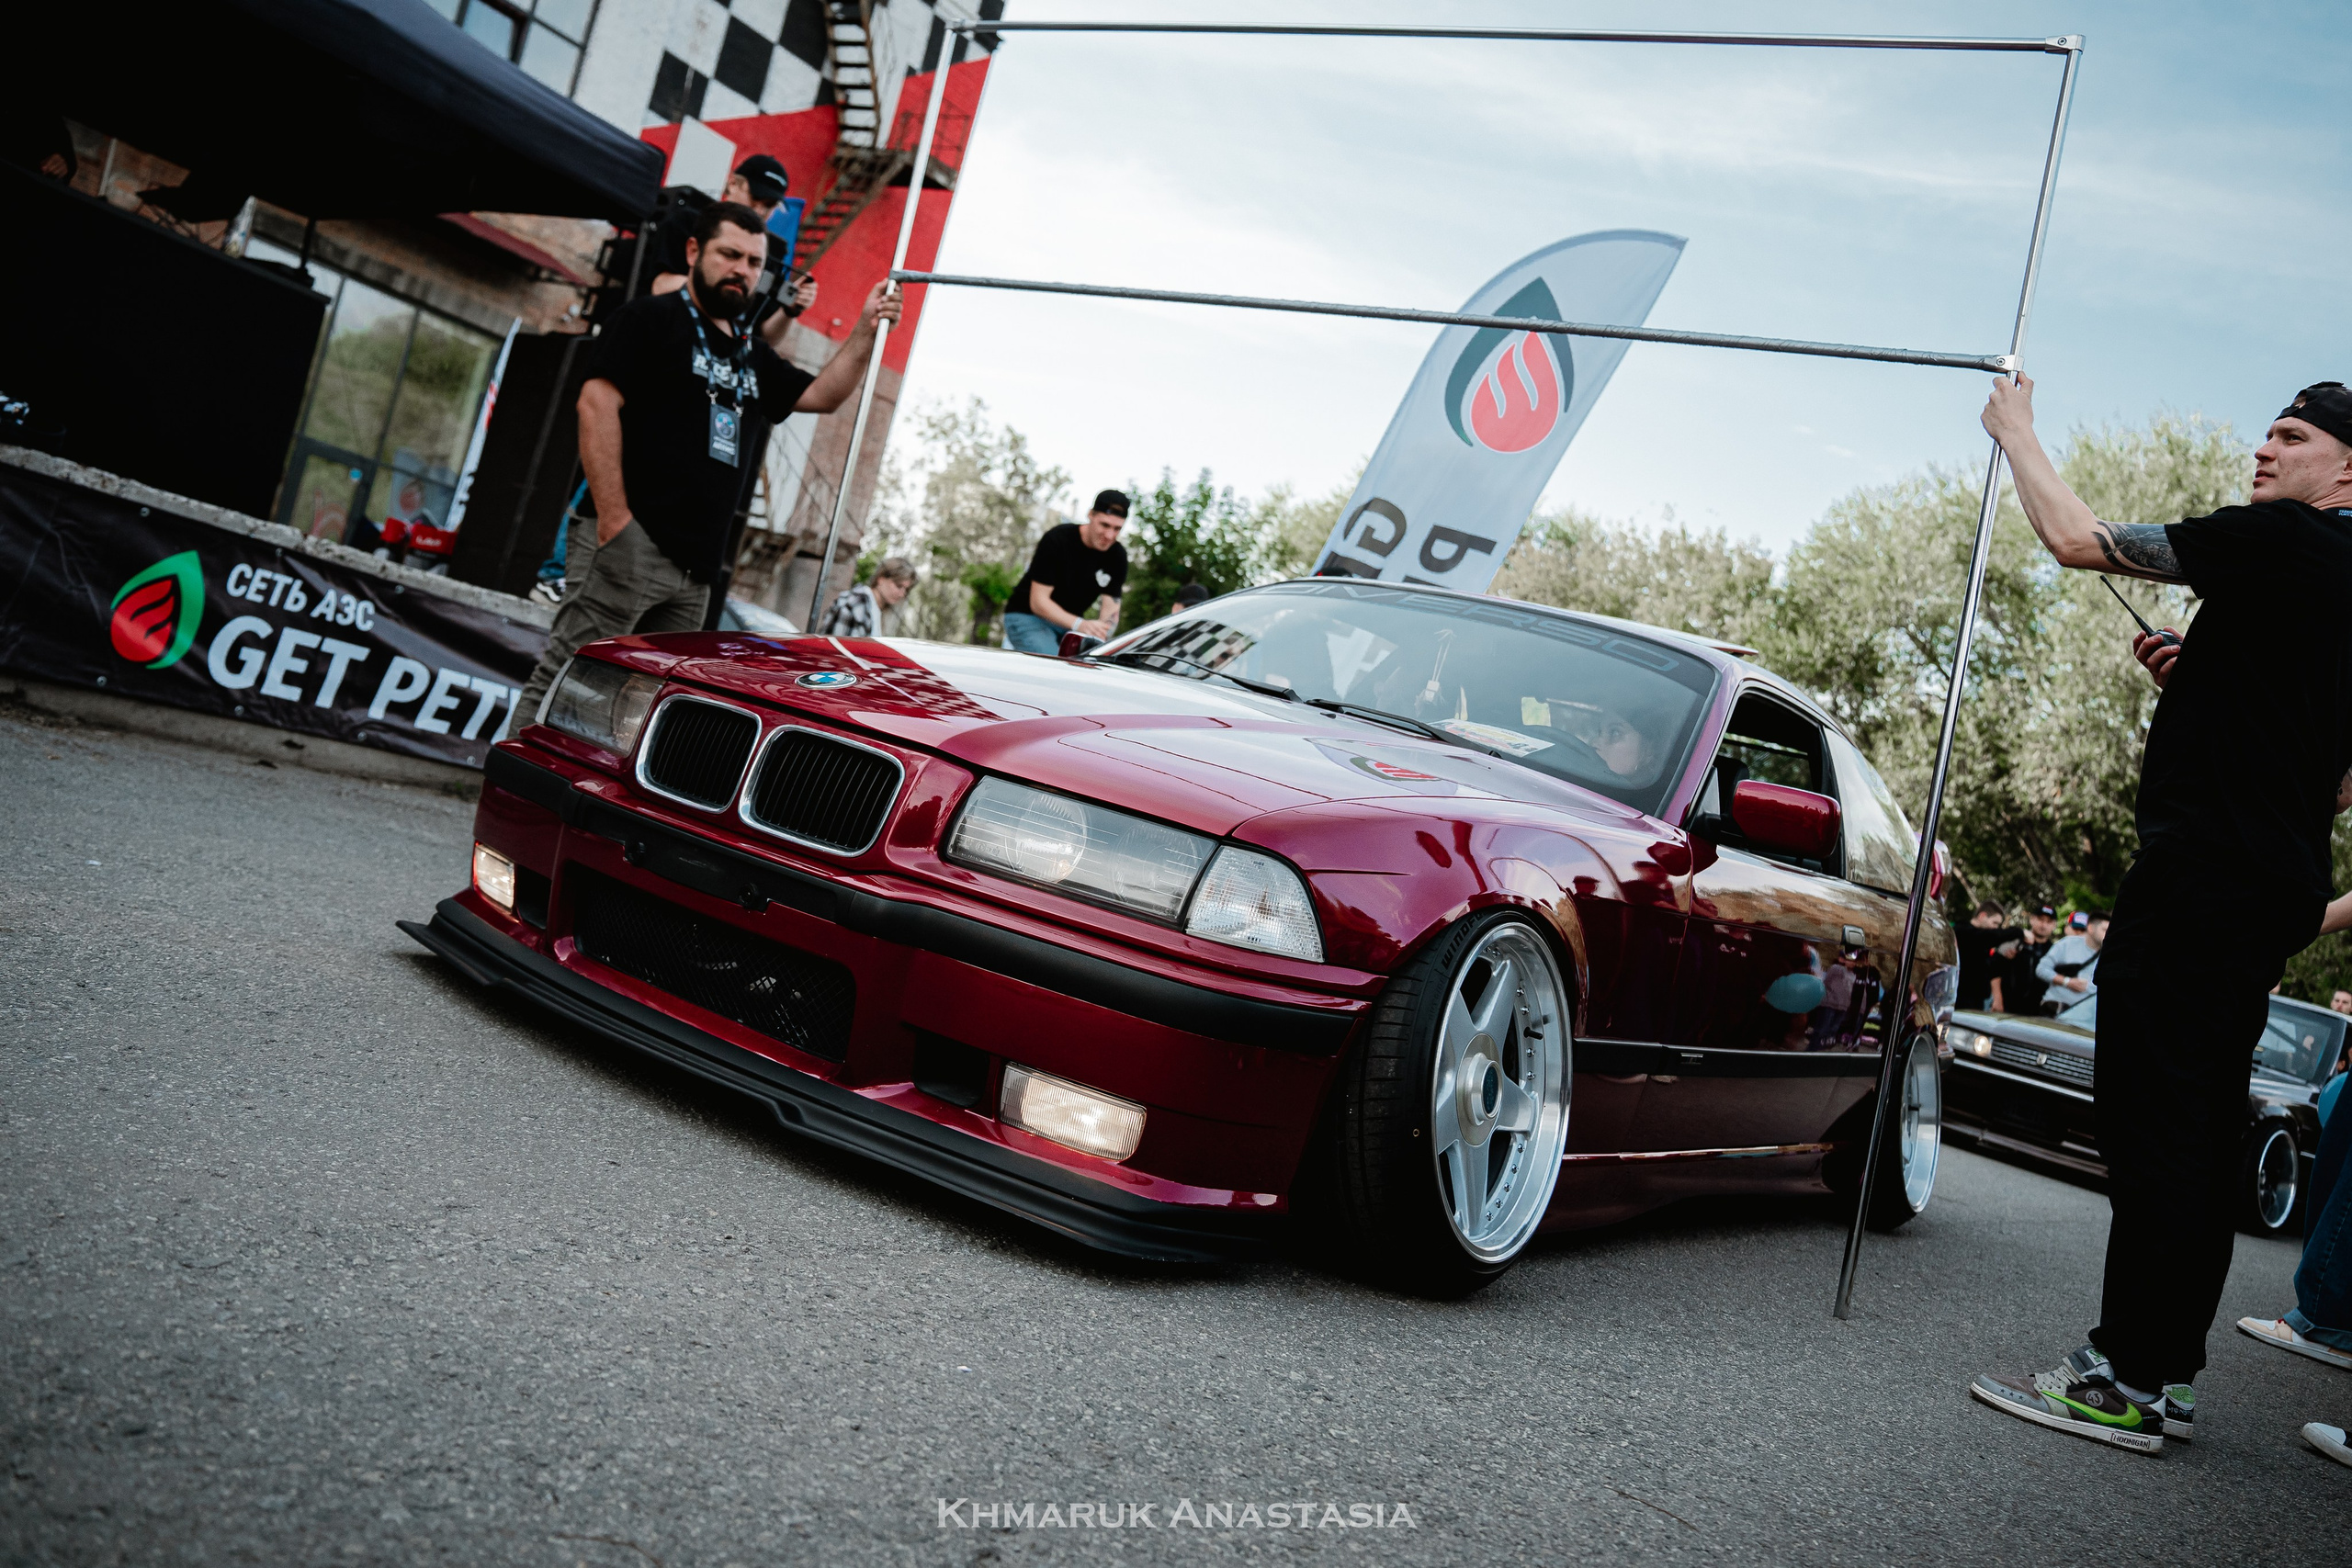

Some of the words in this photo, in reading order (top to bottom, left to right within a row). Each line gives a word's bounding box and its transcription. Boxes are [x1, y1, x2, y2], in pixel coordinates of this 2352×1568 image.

[226, 562, 308, 613] СЕТЬ
[310, 588, 376, 632] АЗС
[207, 615, 371, 709] GET
[1440, 912, 1485, 970] WINDFO
